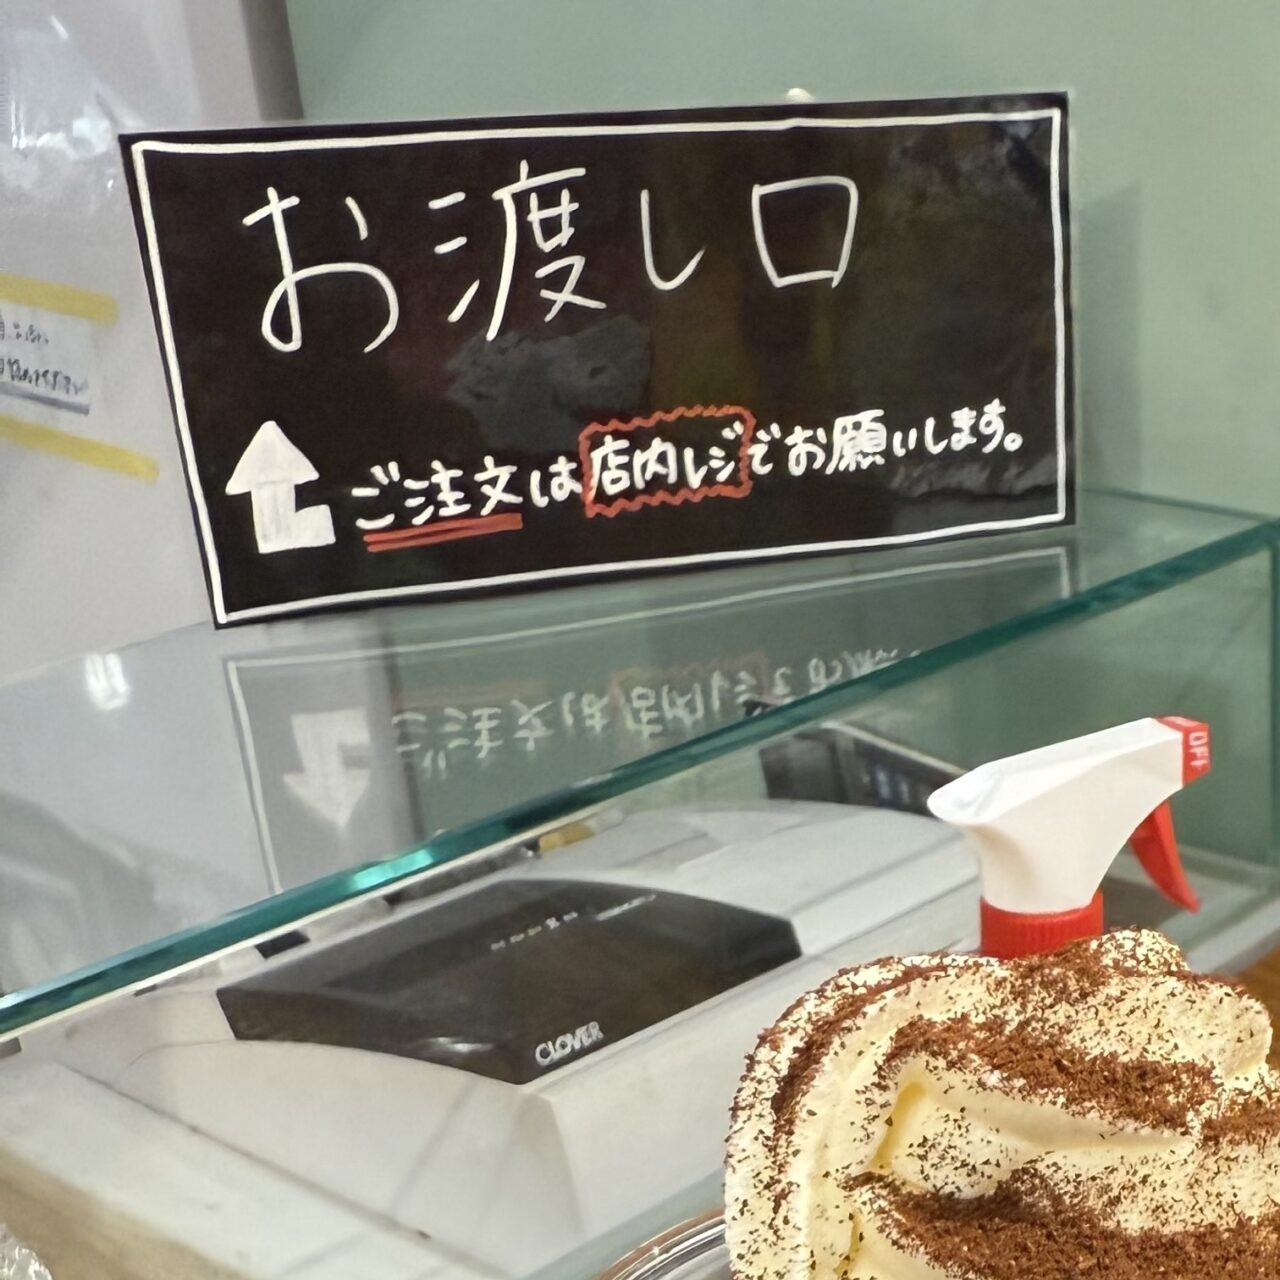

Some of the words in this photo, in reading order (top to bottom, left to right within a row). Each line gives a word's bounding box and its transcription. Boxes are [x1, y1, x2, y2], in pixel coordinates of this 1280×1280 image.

[242, 159, 858, 353] お渡し口
[351, 398, 1023, 530] ご注文は店内レジでお願いします。
[534, 1021, 605, 1067] CLOVER
